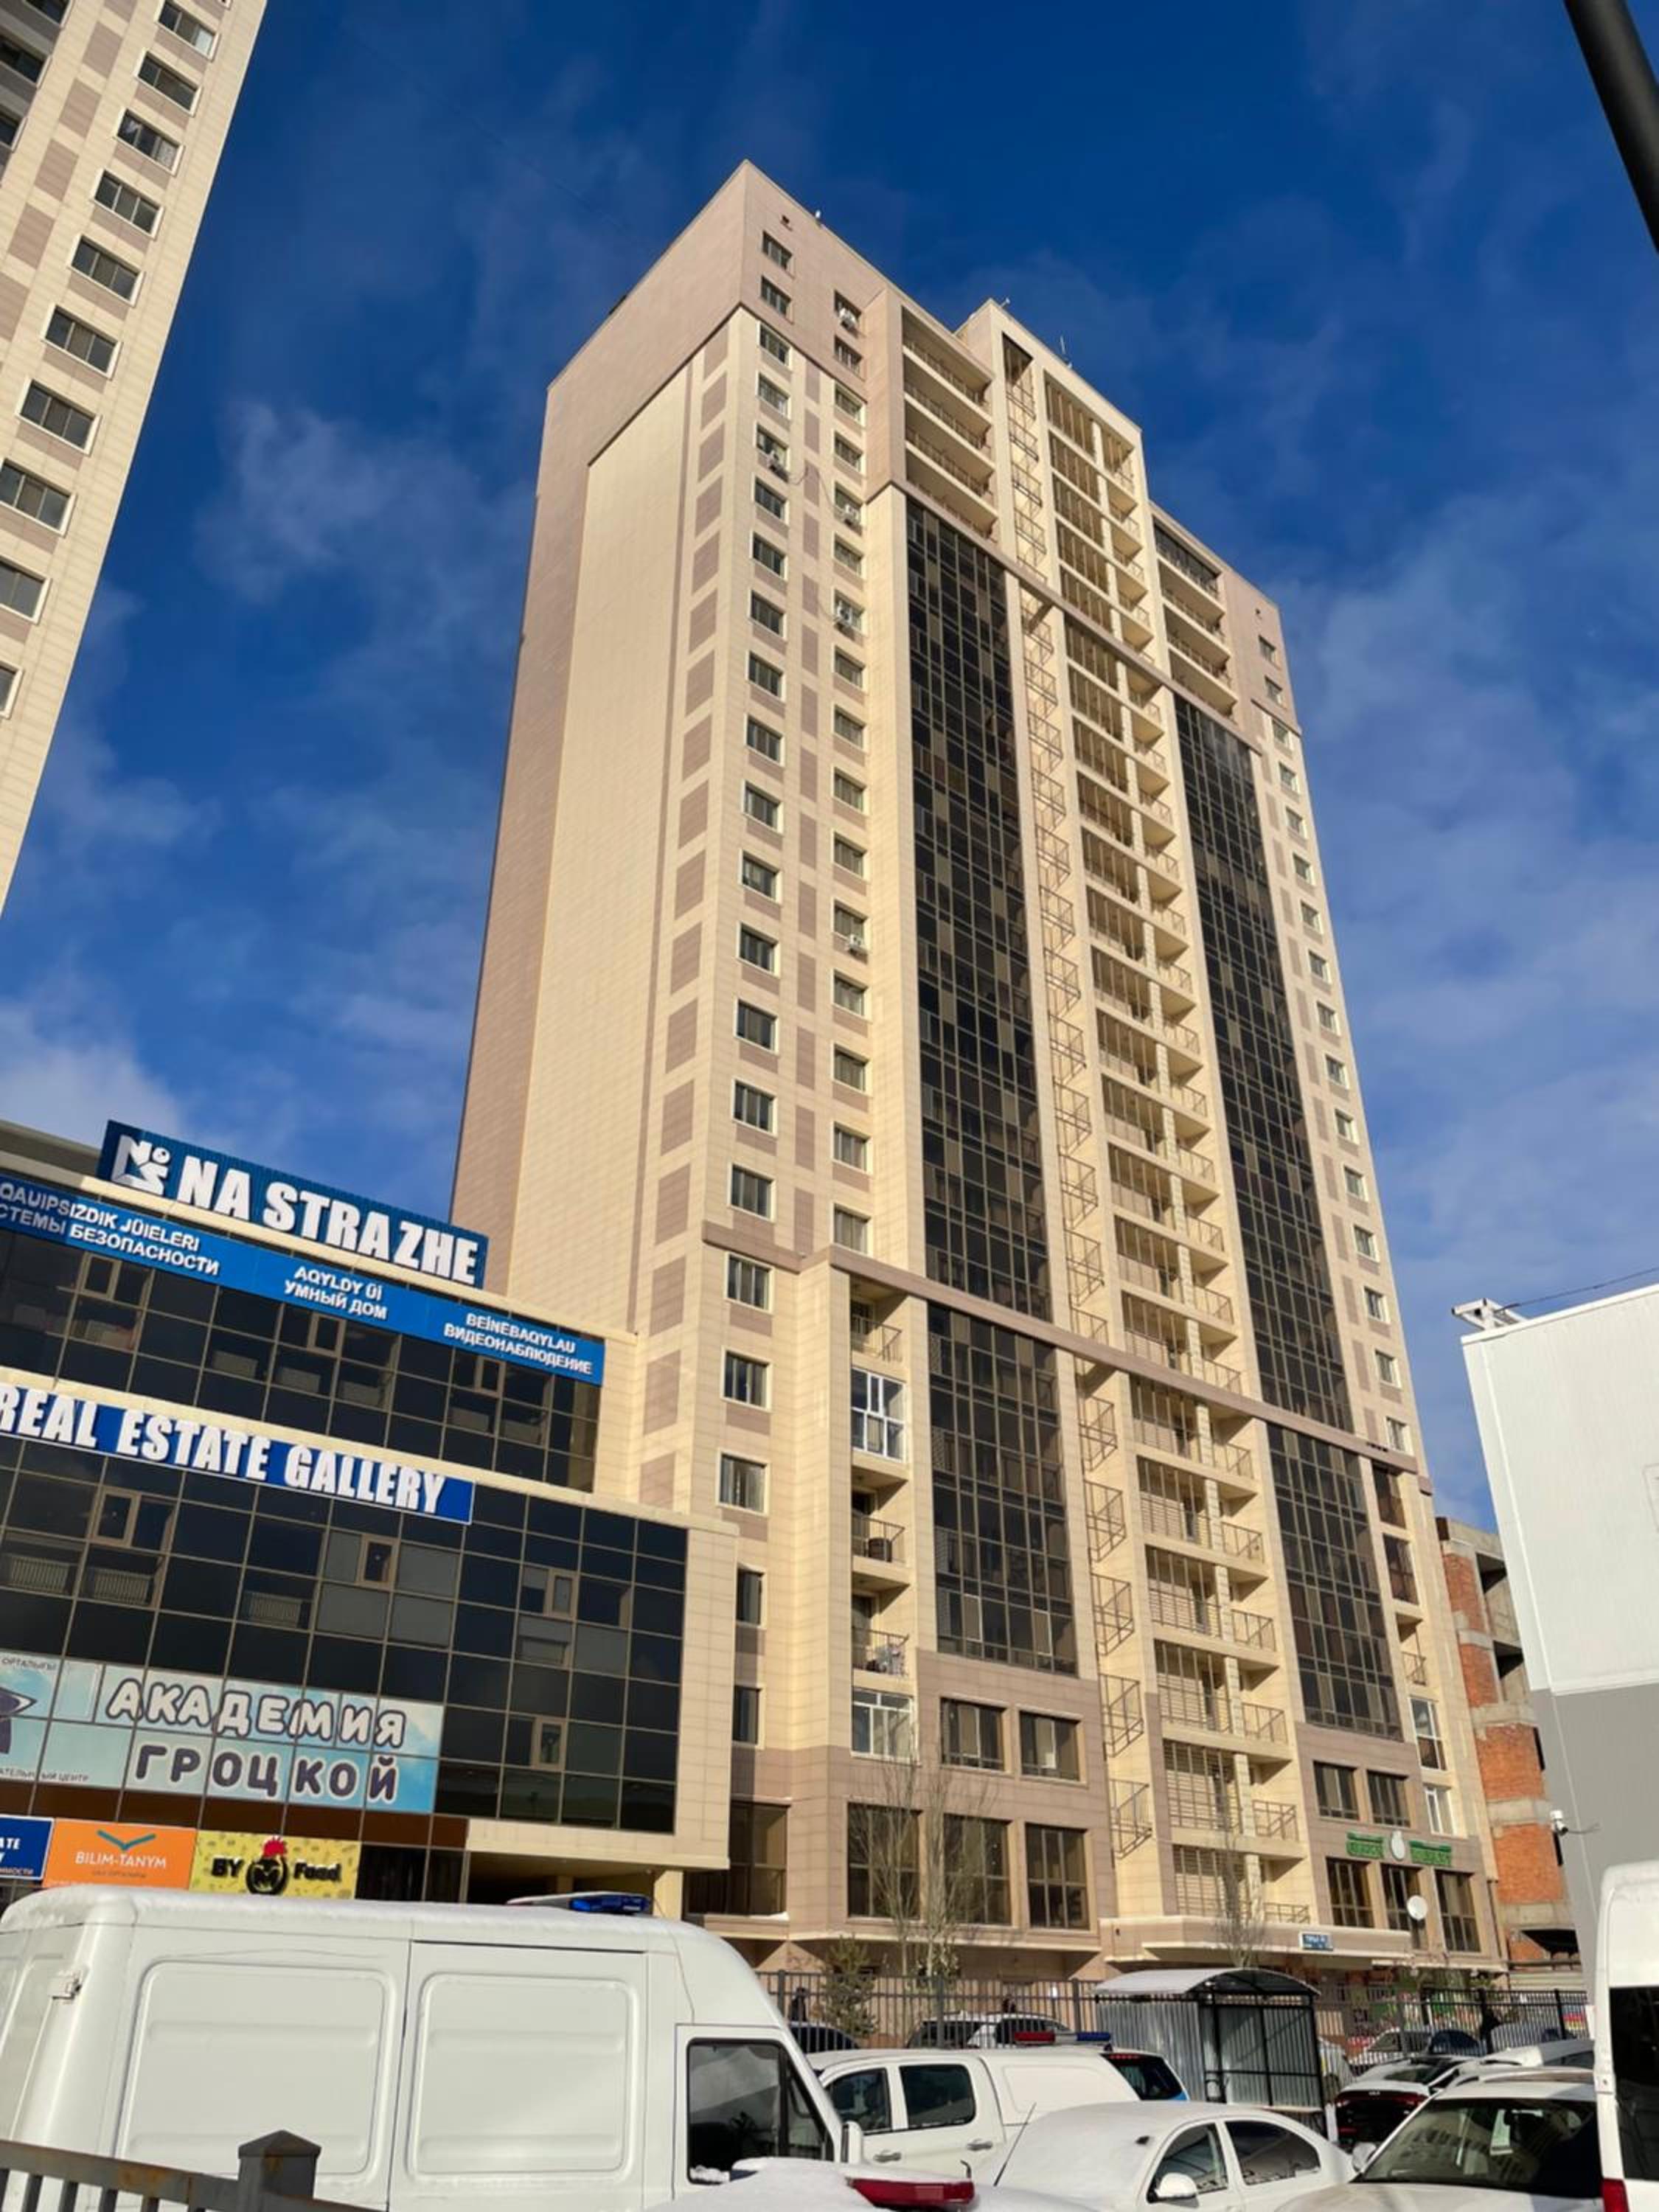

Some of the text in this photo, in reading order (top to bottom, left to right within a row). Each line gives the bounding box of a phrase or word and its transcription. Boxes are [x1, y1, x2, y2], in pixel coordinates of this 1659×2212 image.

[176, 1155, 479, 1285] NA STRAZHE
[69, 1223, 220, 1276] БЕЗОПАСНОСТИ
[285, 1279, 387, 1320] УМНЫЙ ДОМ
[294, 1266, 364, 1295] AQYLDY
[444, 1323, 593, 1375] ВИДЕОНАБЛЮДЕНИЕ
[0, 1385, 446, 1514] REAL ESTATE GALLERY
[106, 1678, 406, 1747] АКАДЕМИЯ
[135, 1745, 397, 1801] ГРОЦКОЙ
[75, 1851, 167, 1869] BILIM-TANYM
[212, 1857, 243, 1877] BY
